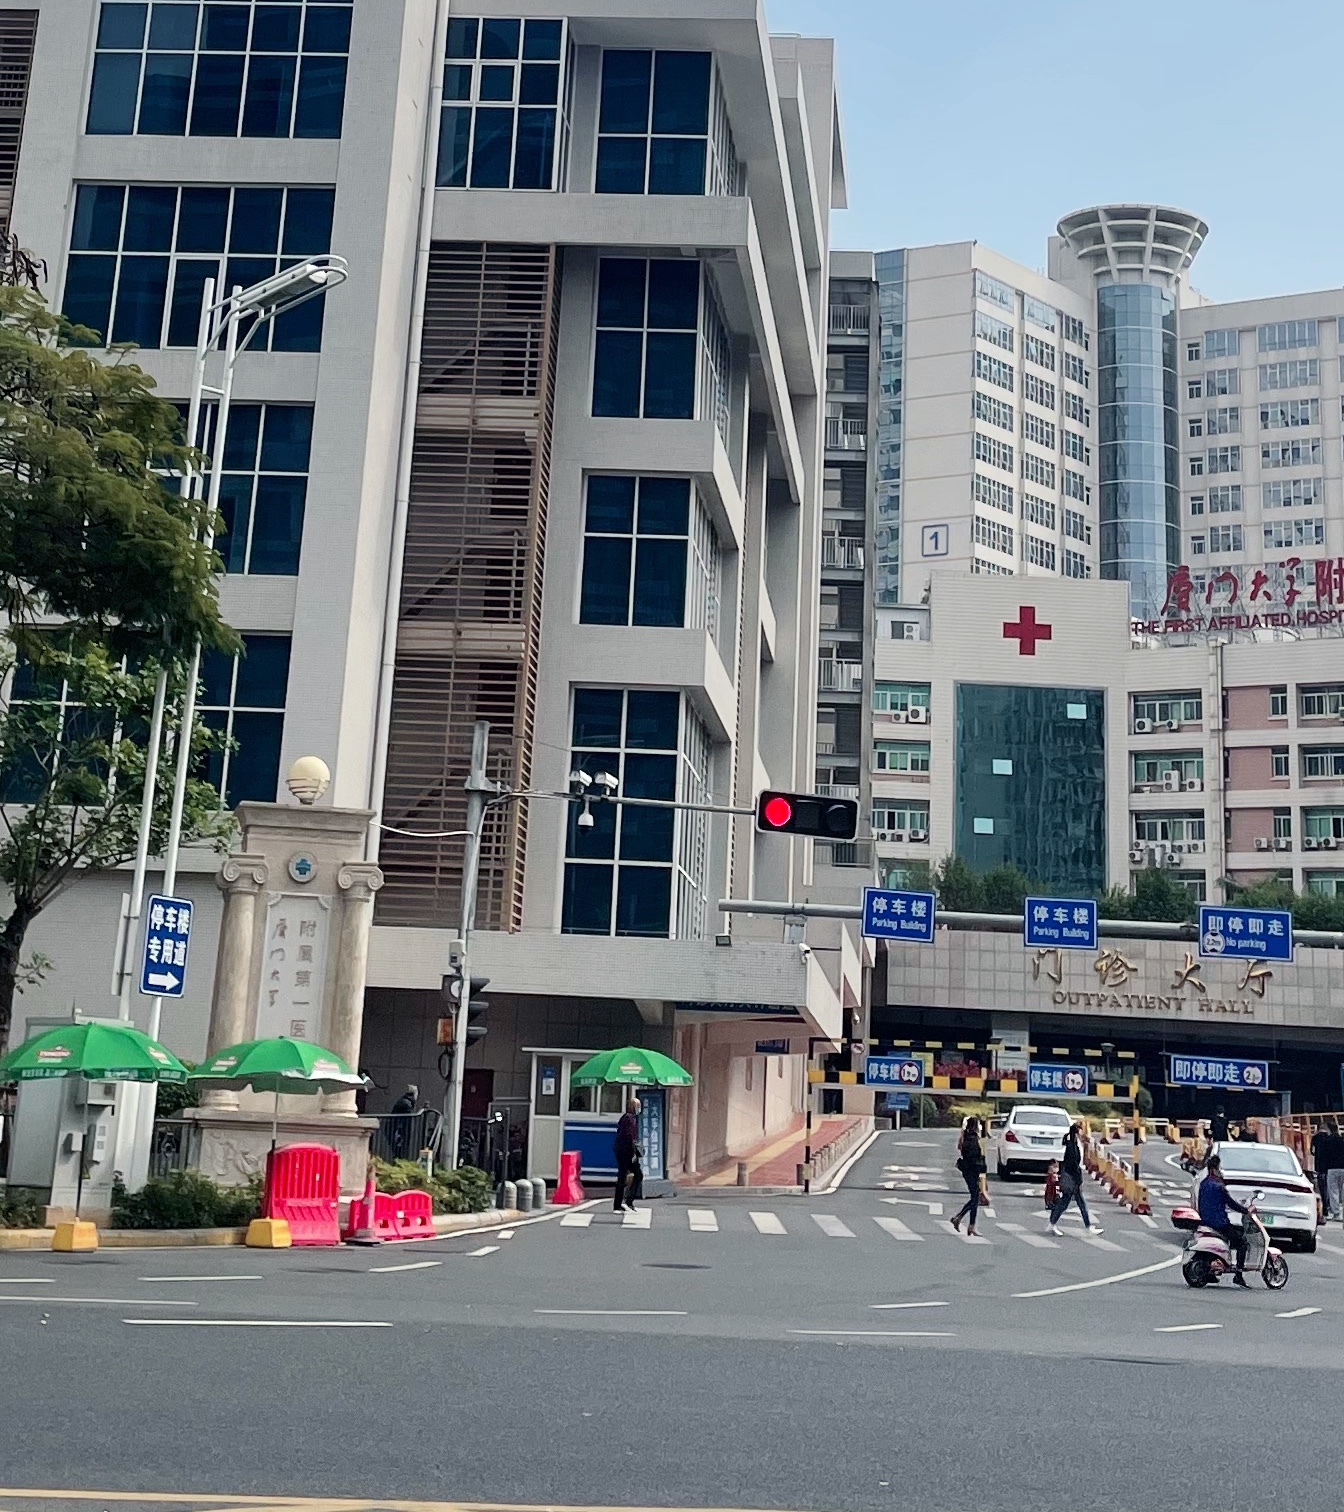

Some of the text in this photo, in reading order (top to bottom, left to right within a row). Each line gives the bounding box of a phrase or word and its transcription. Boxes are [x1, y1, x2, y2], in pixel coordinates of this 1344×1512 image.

[929, 531, 939, 551] 1
[1132, 620, 1157, 635] THE
[1162, 616, 1203, 633] FIRST
[1208, 612, 1292, 631] AFFILIATED
[872, 896, 927, 918] 停车楼
[1033, 905, 1089, 925] 停车楼
[150, 903, 190, 935] 停车楼
[872, 916, 927, 933] Parking Building
[1207, 915, 1285, 937] 即停即走
[1033, 925, 1090, 941] Parking Building
[1225, 936, 1267, 952] No parking
[147, 935, 187, 967] 专用道
[1032, 947, 1273, 998] 门诊大厅
[1052, 990, 1255, 1015] OUTPATIENT HALL
[868, 1062, 900, 1080] 停车楼
[1031, 1069, 1063, 1089] 停车楼
[1175, 1059, 1240, 1084] 即停即走
